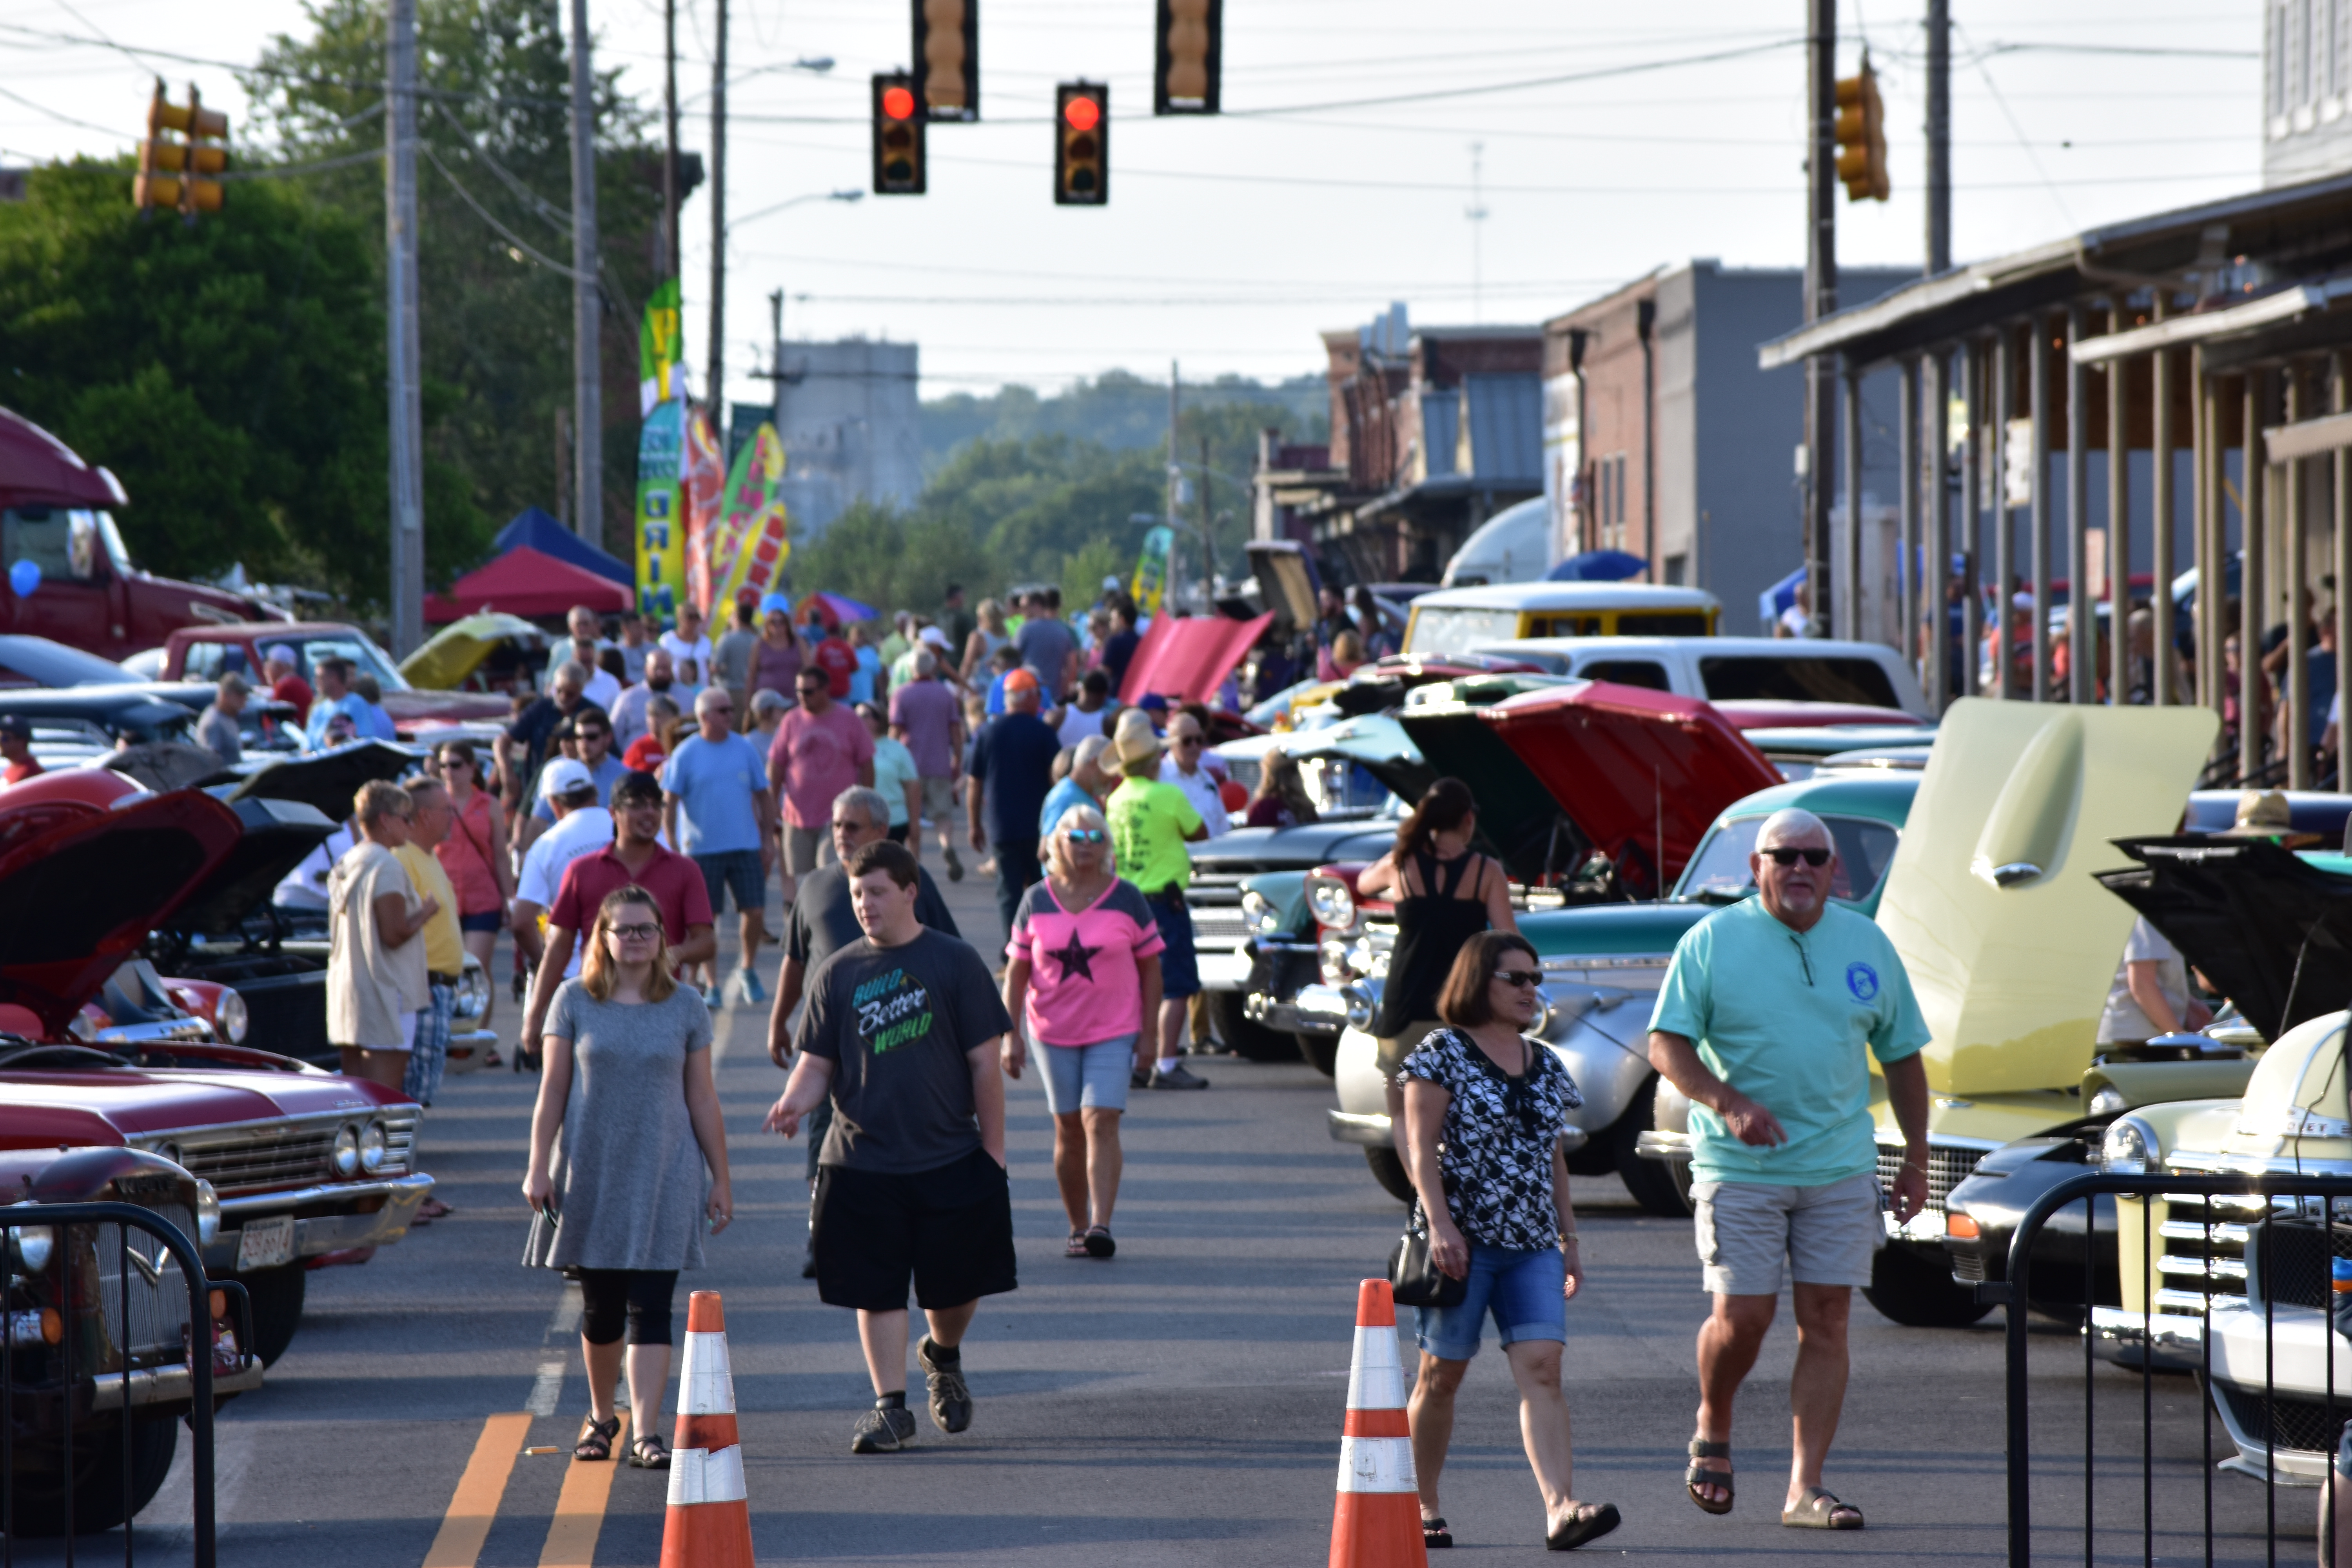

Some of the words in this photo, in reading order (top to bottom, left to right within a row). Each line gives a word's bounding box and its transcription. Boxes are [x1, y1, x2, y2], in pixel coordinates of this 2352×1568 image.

[853, 968, 903, 1007] BUILD
[858, 987, 926, 1036] Better
[874, 1012, 932, 1054] WORLD
